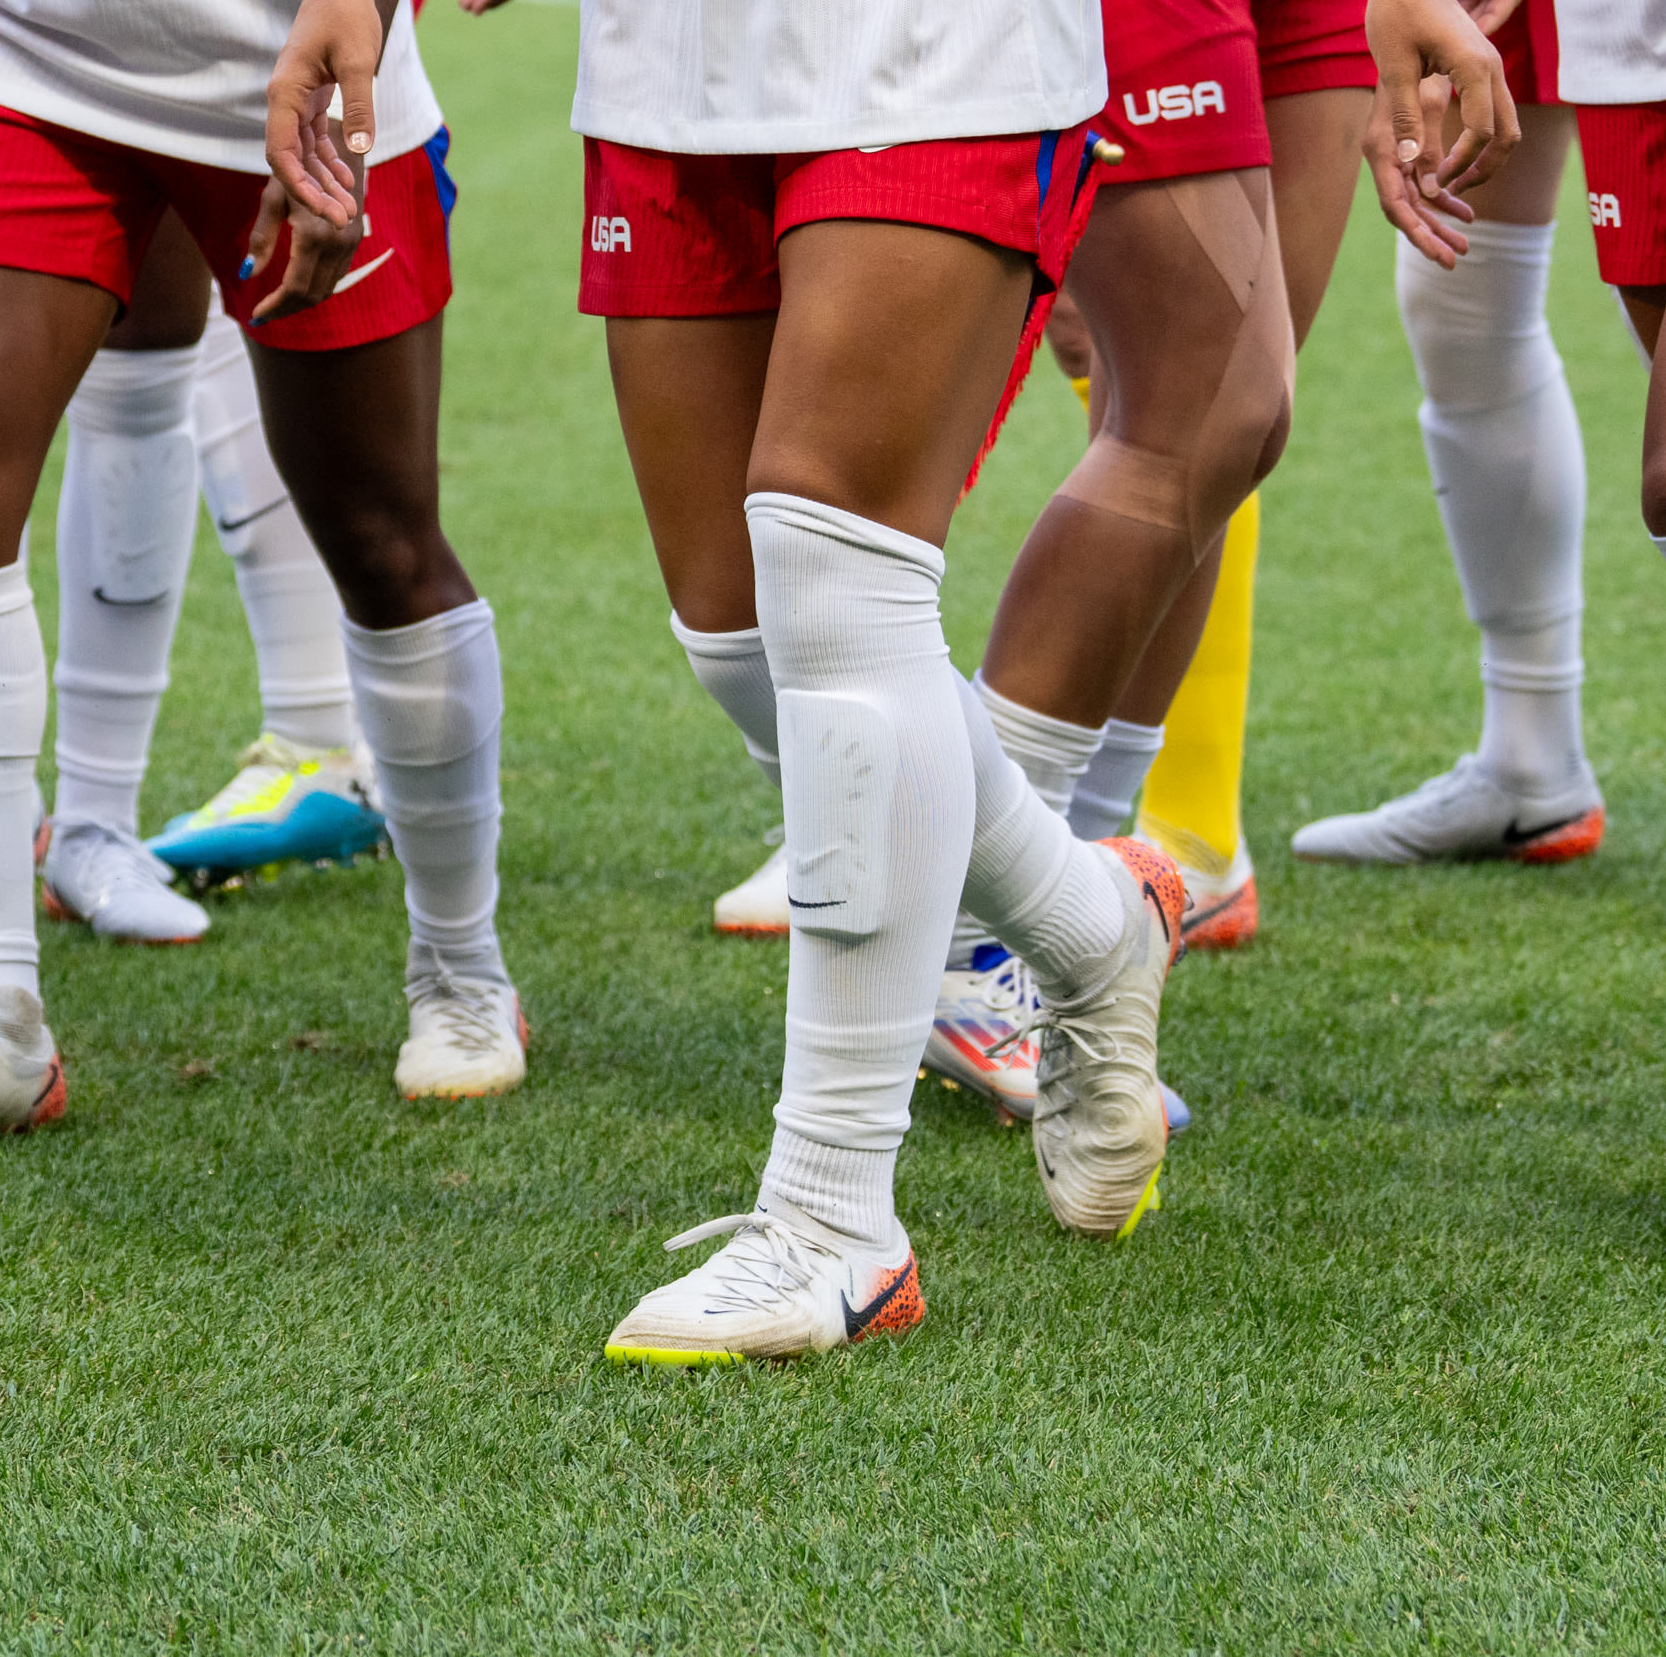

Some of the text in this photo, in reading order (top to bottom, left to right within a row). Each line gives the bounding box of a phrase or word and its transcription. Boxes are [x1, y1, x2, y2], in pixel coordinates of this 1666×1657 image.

[1124, 80, 1226, 125] USA
[1588, 192, 1622, 228] SA
[591, 216, 632, 253] USA
